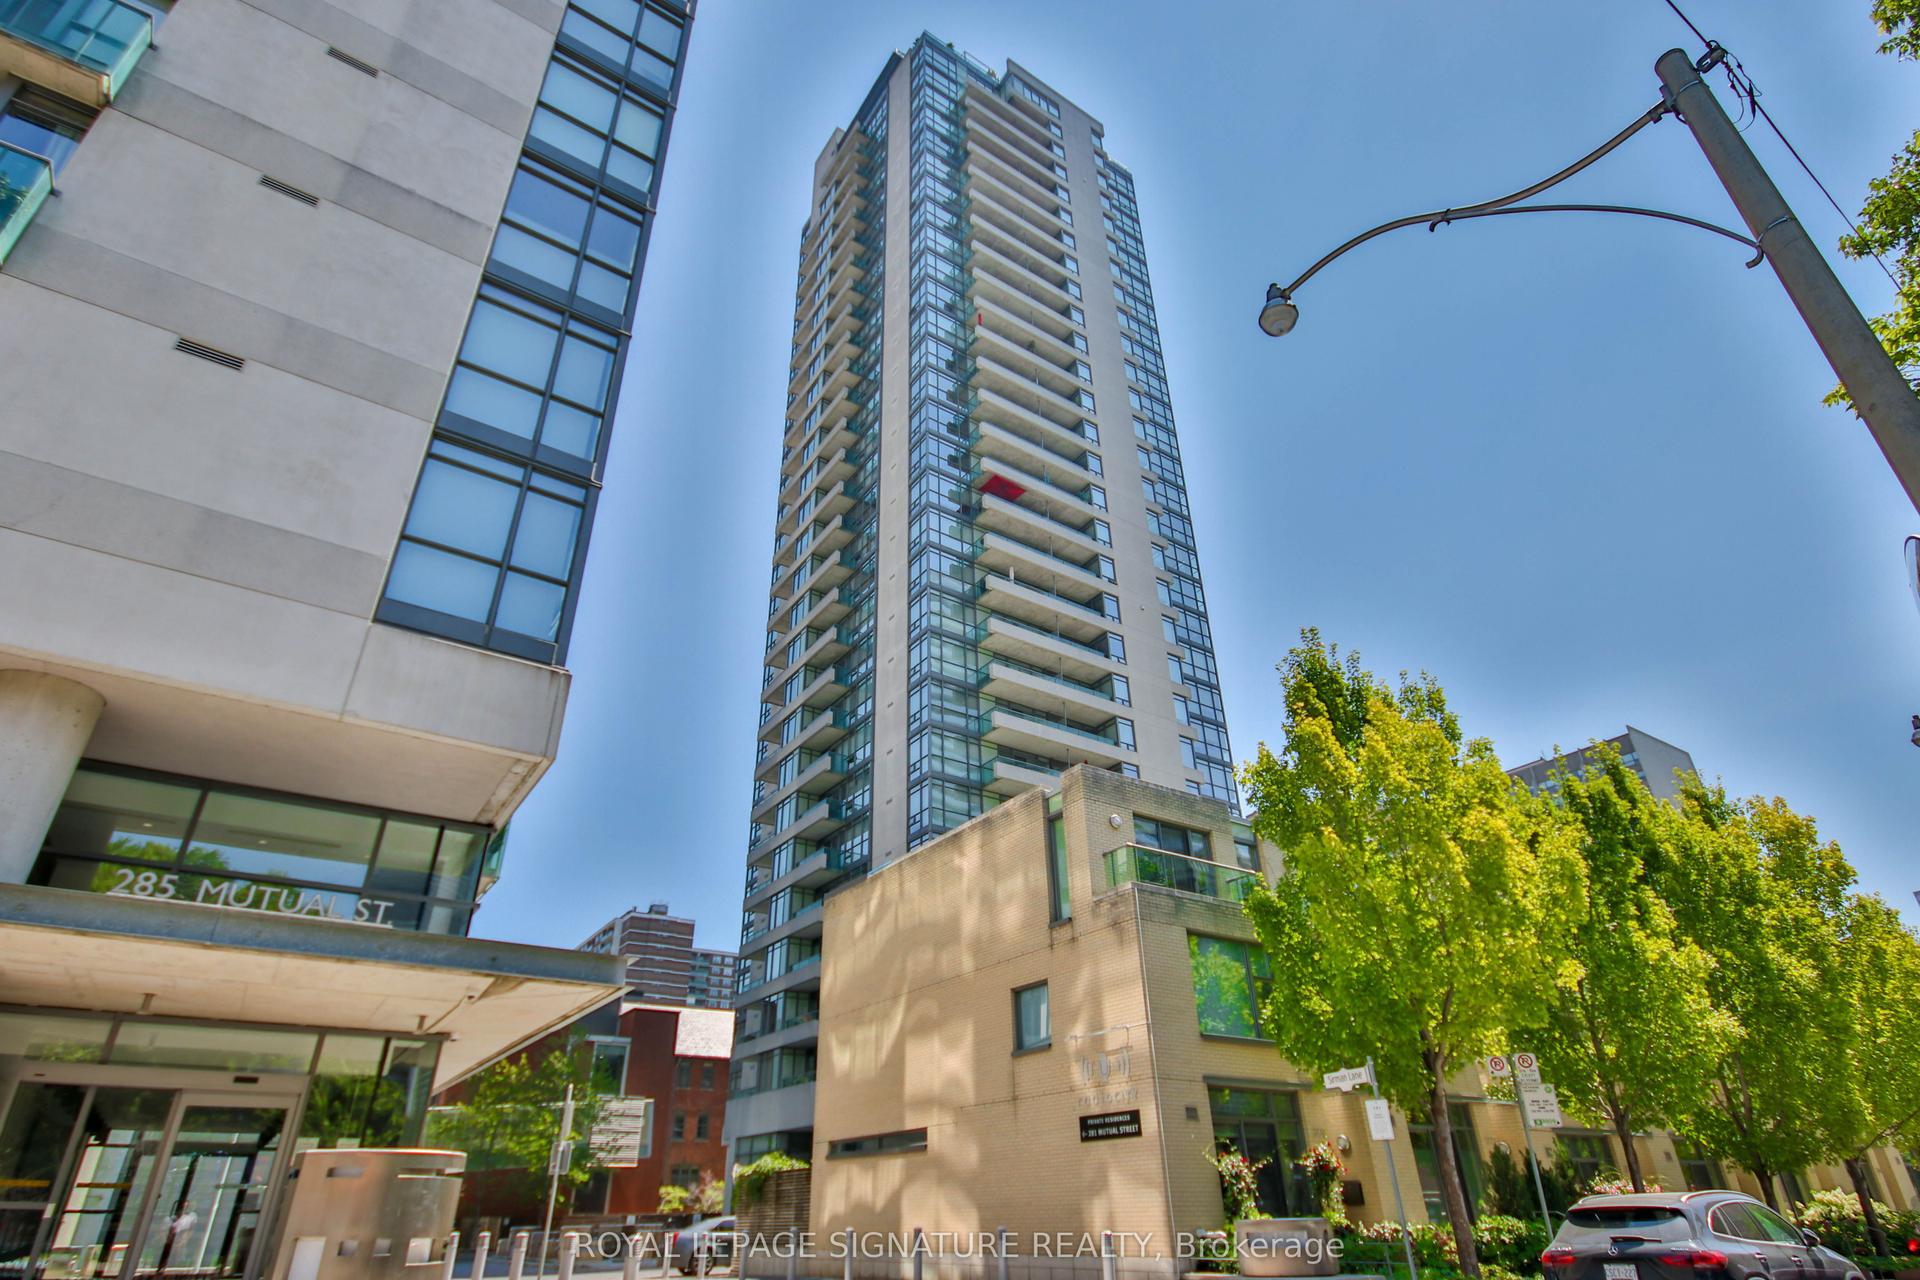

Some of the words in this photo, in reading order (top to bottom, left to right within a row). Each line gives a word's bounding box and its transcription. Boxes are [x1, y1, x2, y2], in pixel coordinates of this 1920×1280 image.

[111, 868, 179, 899] 285
[196, 879, 343, 920] MUTUAL
[1348, 1072, 1362, 1081] Lane
[1105, 1114, 1130, 1123] RESIDENCES
[1098, 1127, 1118, 1136] MUTUAL
[1119, 1125, 1138, 1134] STREET
